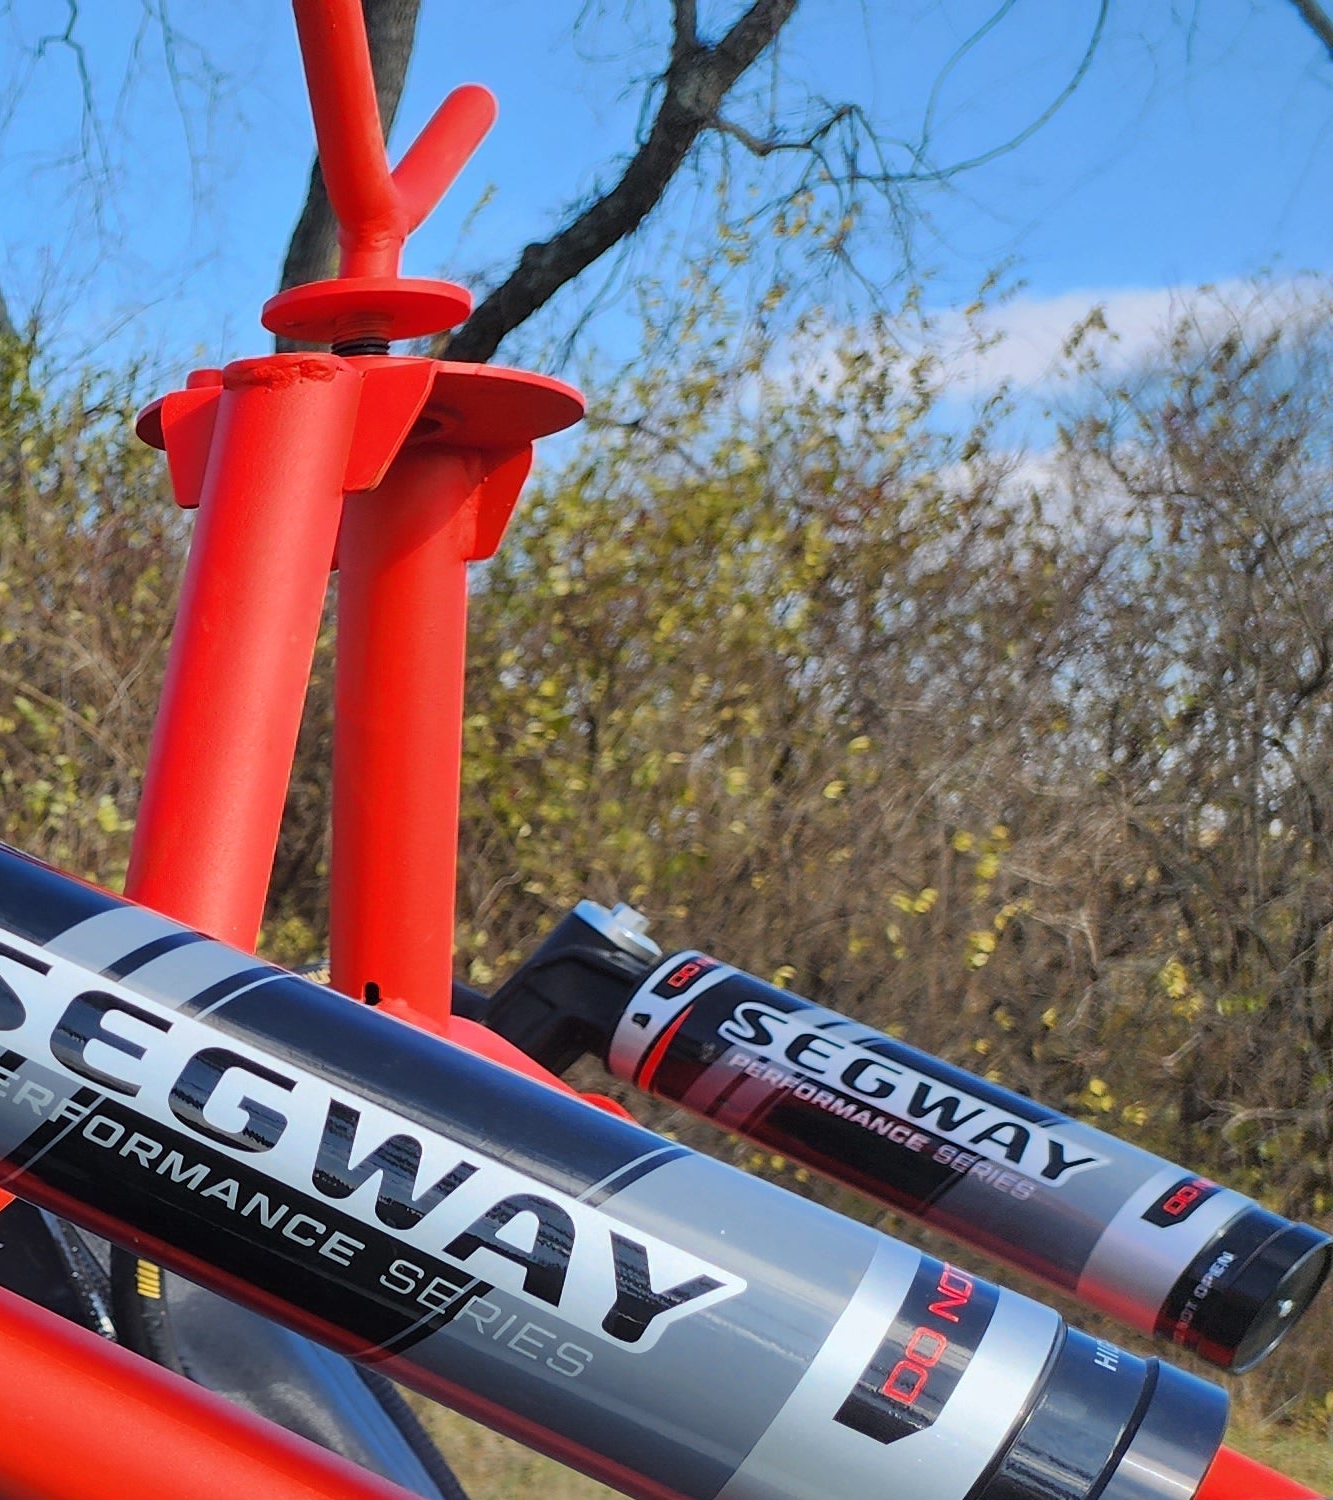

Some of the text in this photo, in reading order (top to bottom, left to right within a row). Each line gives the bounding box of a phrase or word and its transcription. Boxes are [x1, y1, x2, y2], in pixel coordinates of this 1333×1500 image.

[721, 1005, 1099, 1181] SEGWAY
[729, 1053, 1038, 1201] PERFORMANCE SERIES
[1163, 1184, 1200, 1216] DO
[379, 1258, 594, 1378] SERIES
[883, 1326, 948, 1405] DO
